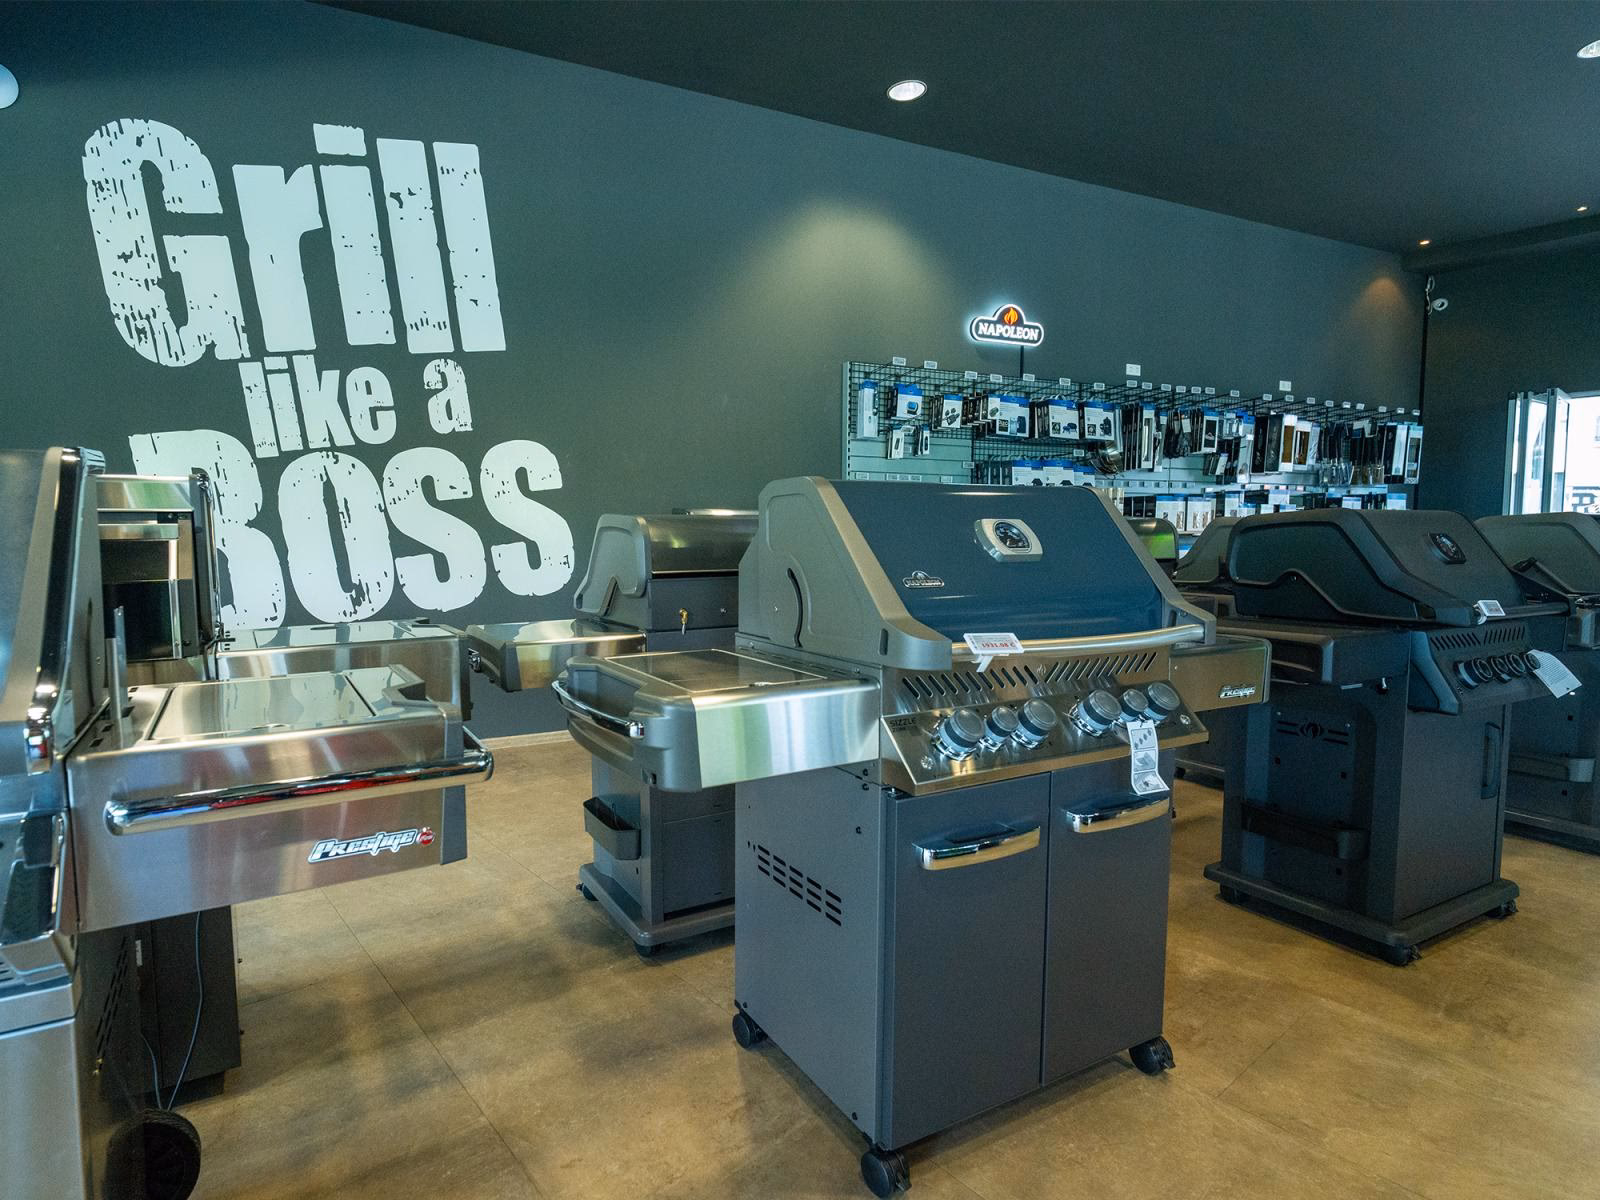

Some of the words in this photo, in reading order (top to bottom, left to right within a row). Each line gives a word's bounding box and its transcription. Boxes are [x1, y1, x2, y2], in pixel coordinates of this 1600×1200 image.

[82, 117, 506, 368] Grill
[977, 321, 1040, 341] NAPOLEON
[238, 354, 398, 460] like
[423, 358, 473, 434] a
